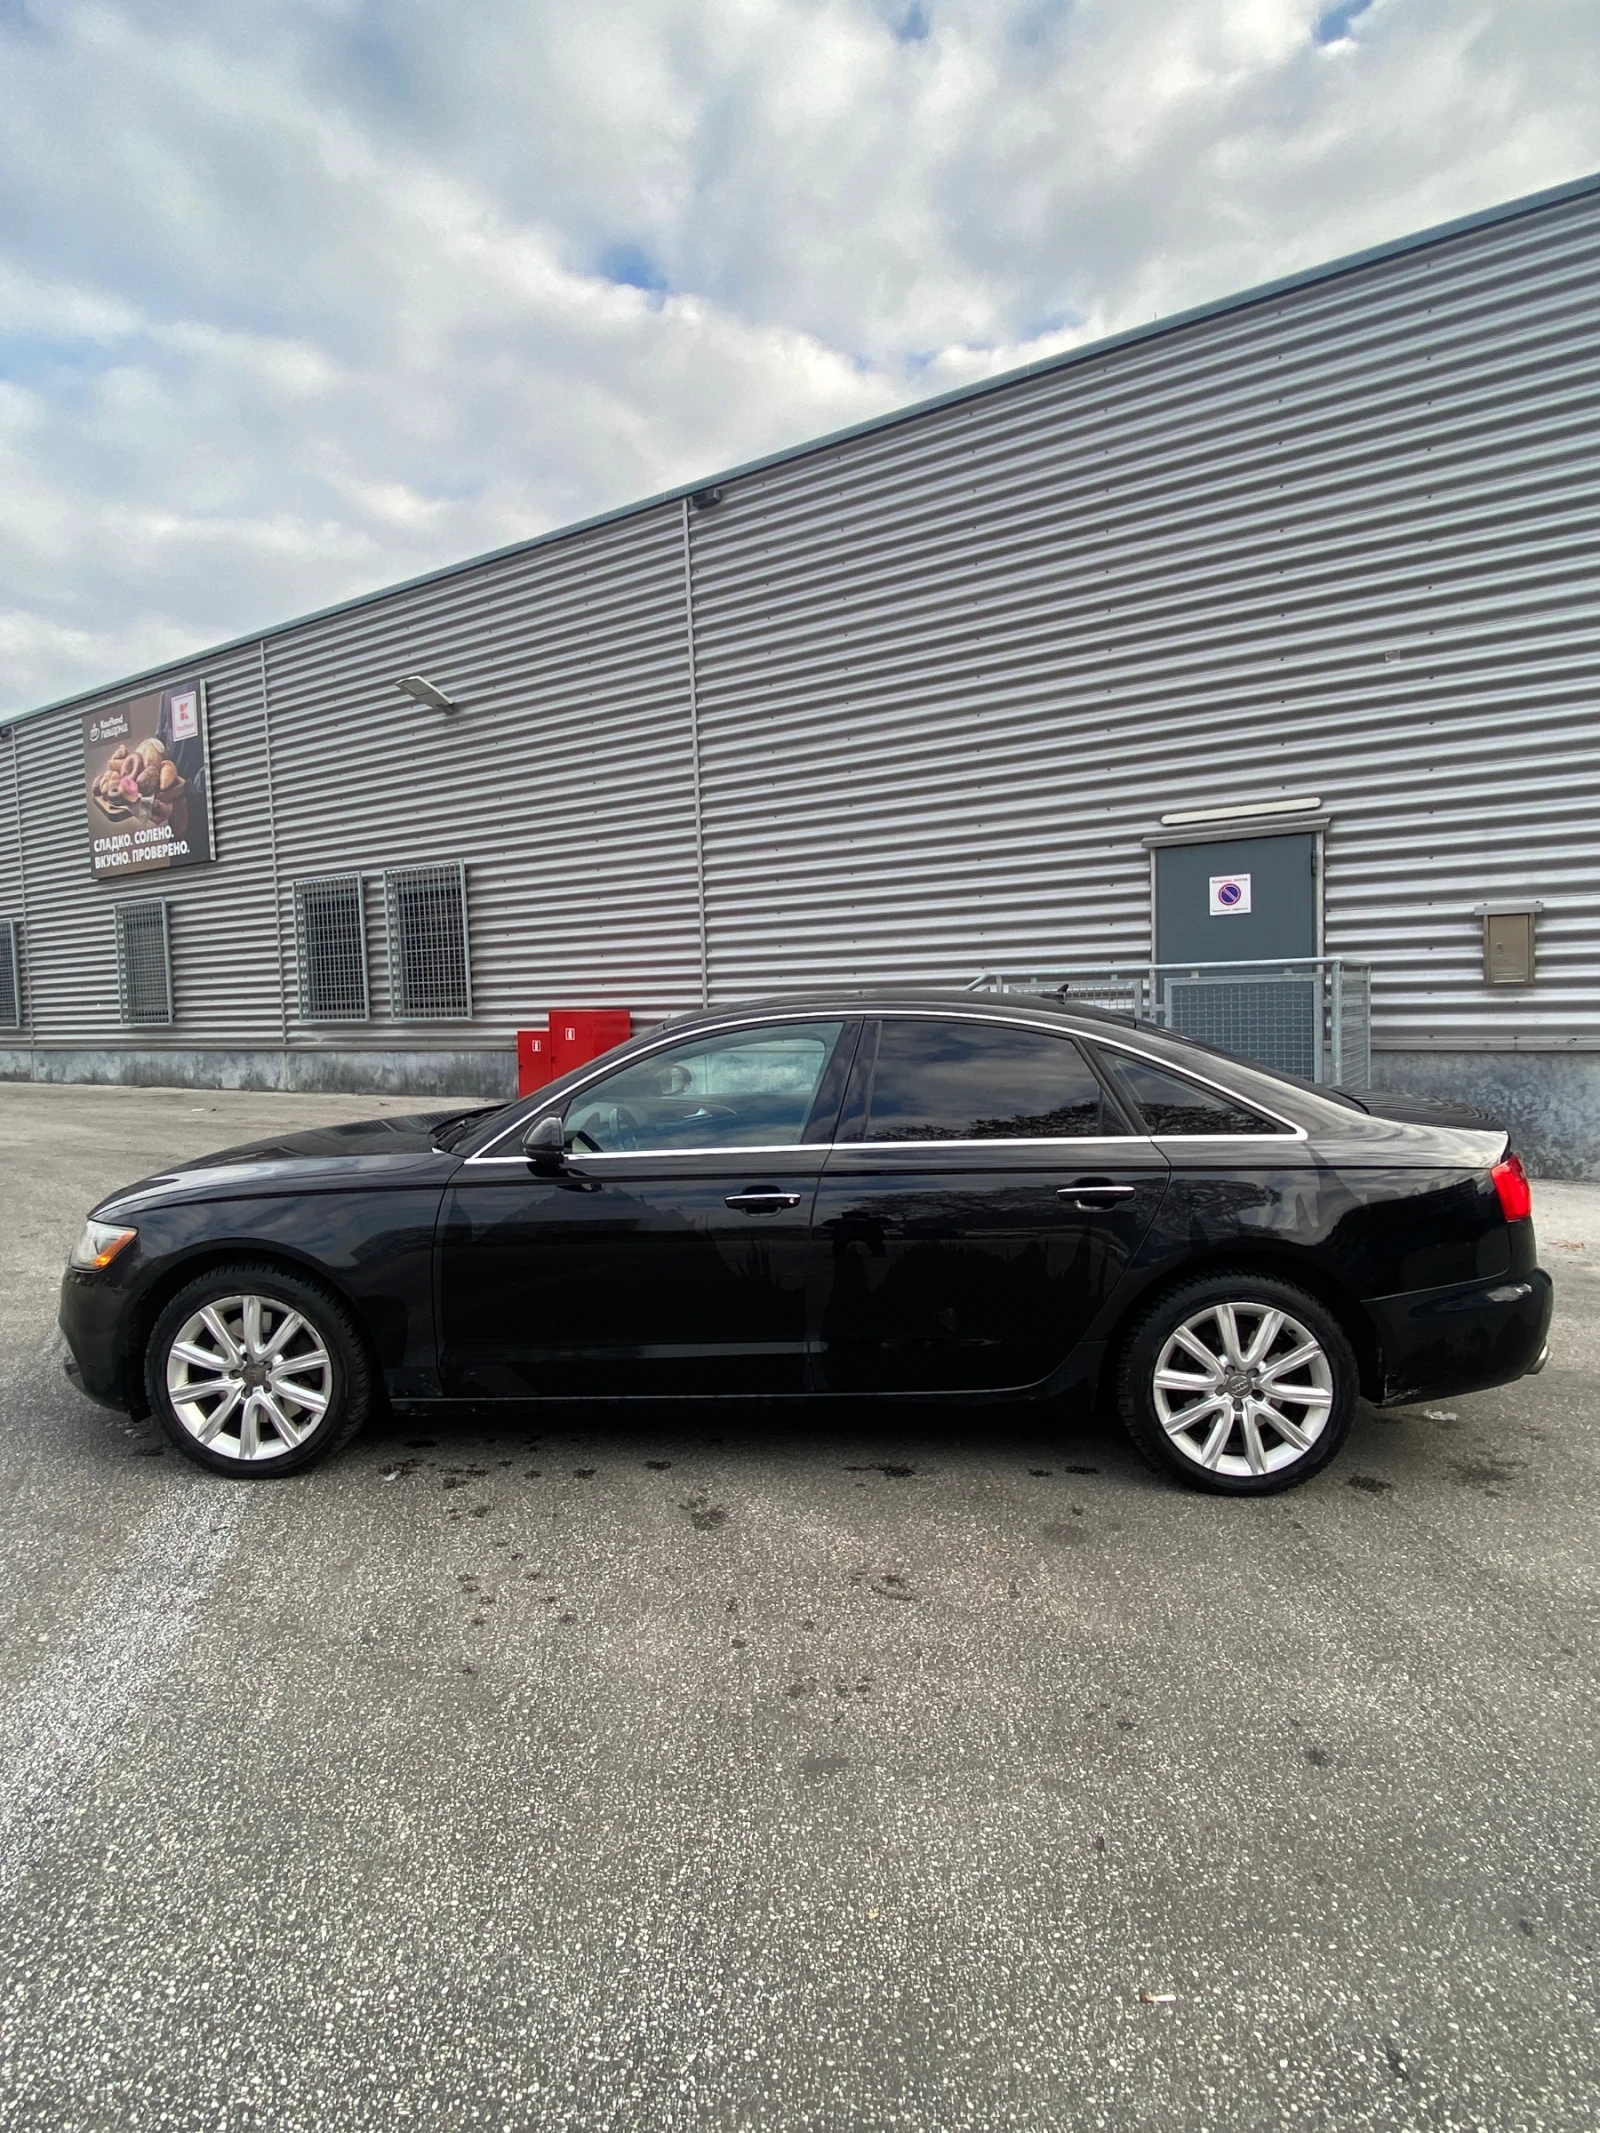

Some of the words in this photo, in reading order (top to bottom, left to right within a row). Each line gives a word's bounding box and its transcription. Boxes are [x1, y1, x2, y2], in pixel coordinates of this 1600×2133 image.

[179, 702, 189, 720] K
[93, 833, 133, 853] СЛАДКО.
[134, 825, 175, 844] СОЛЕНО.
[94, 851, 132, 869] ВКУСНО.
[132, 840, 190, 862] ПРОВЕРЕНО.
